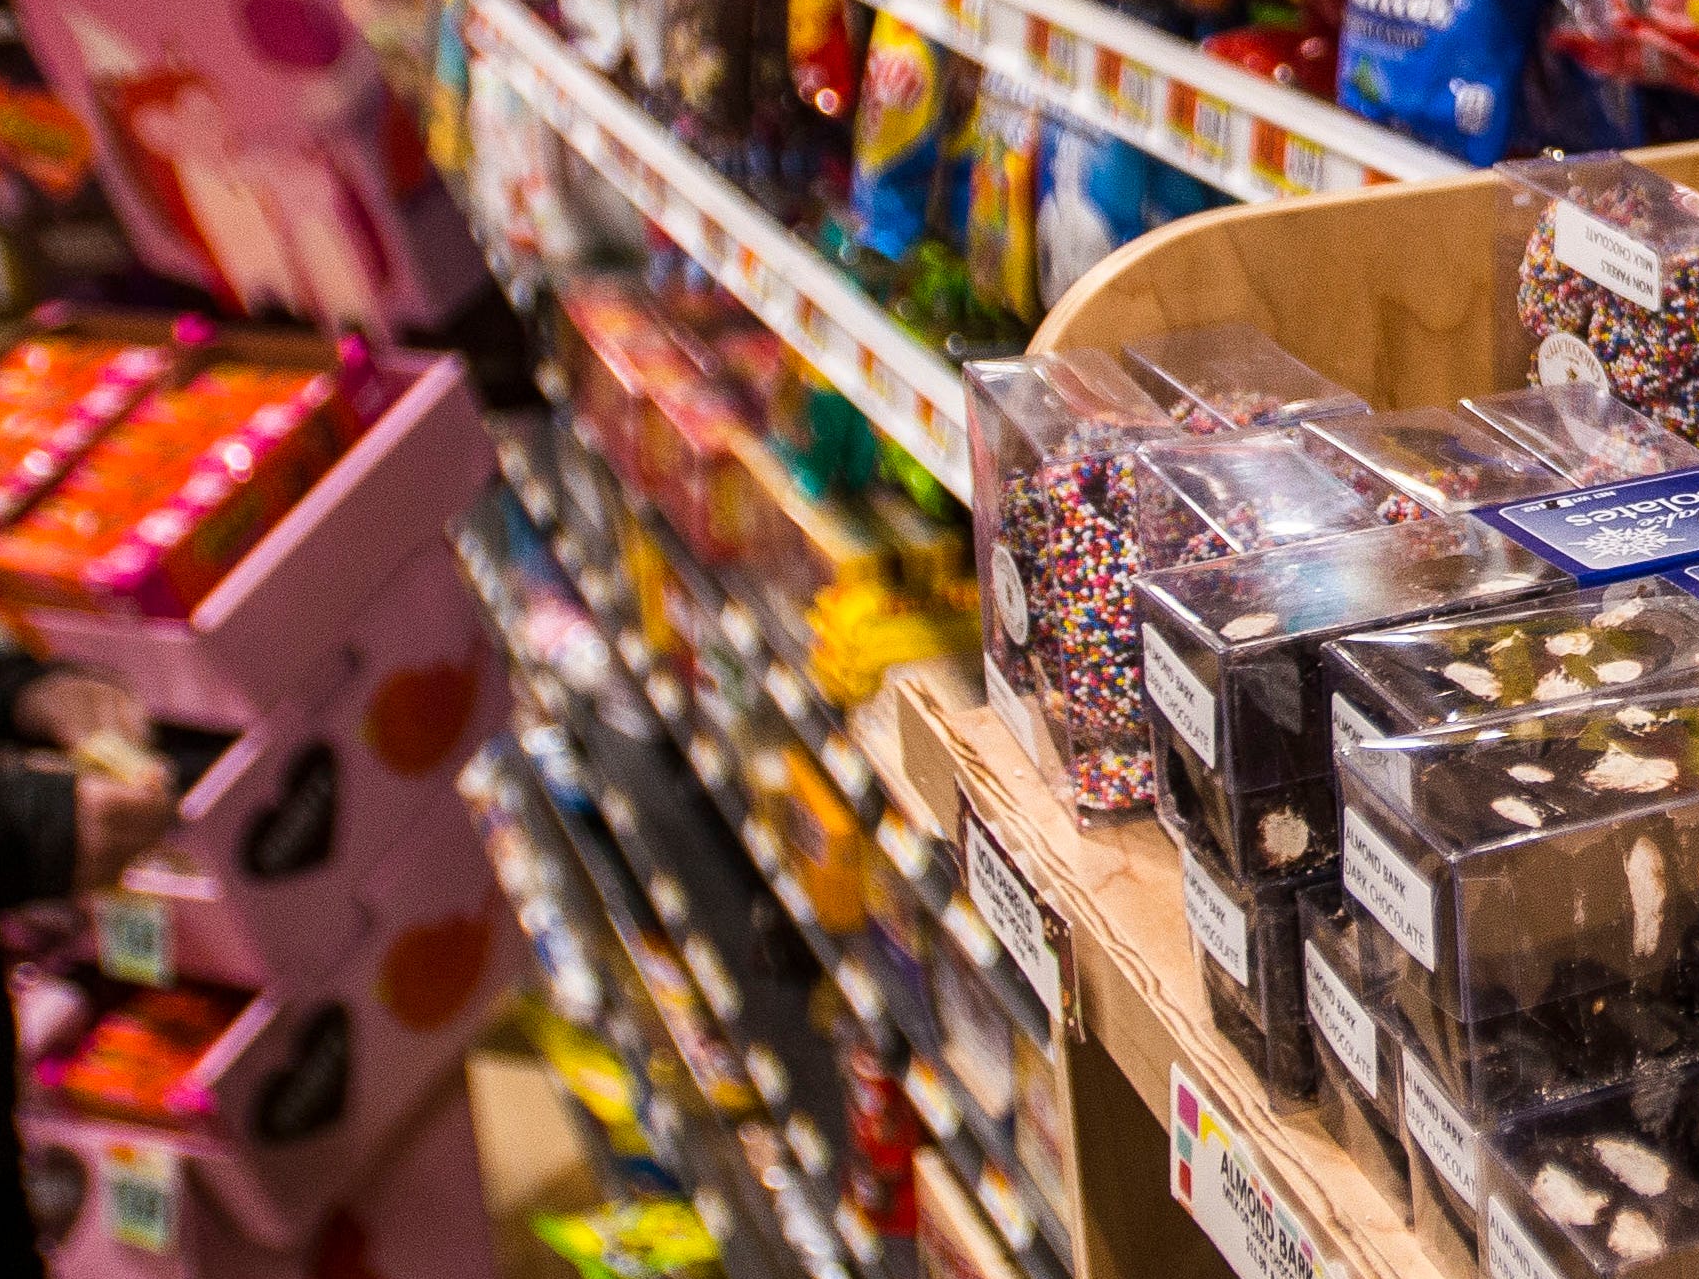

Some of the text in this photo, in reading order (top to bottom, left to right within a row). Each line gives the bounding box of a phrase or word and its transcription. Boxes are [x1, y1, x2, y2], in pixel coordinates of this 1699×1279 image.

[1345, 825, 1408, 902] ALMOND BARK
[1344, 857, 1427, 953] DARK CHOCOLATE
[1405, 1069, 1465, 1151] ALMOND BARK
[1220, 1150, 1276, 1243] ALMOND
[1427, 1132, 1477, 1197] CHOCOLAT
[1490, 1216, 1531, 1277] ALMOND
